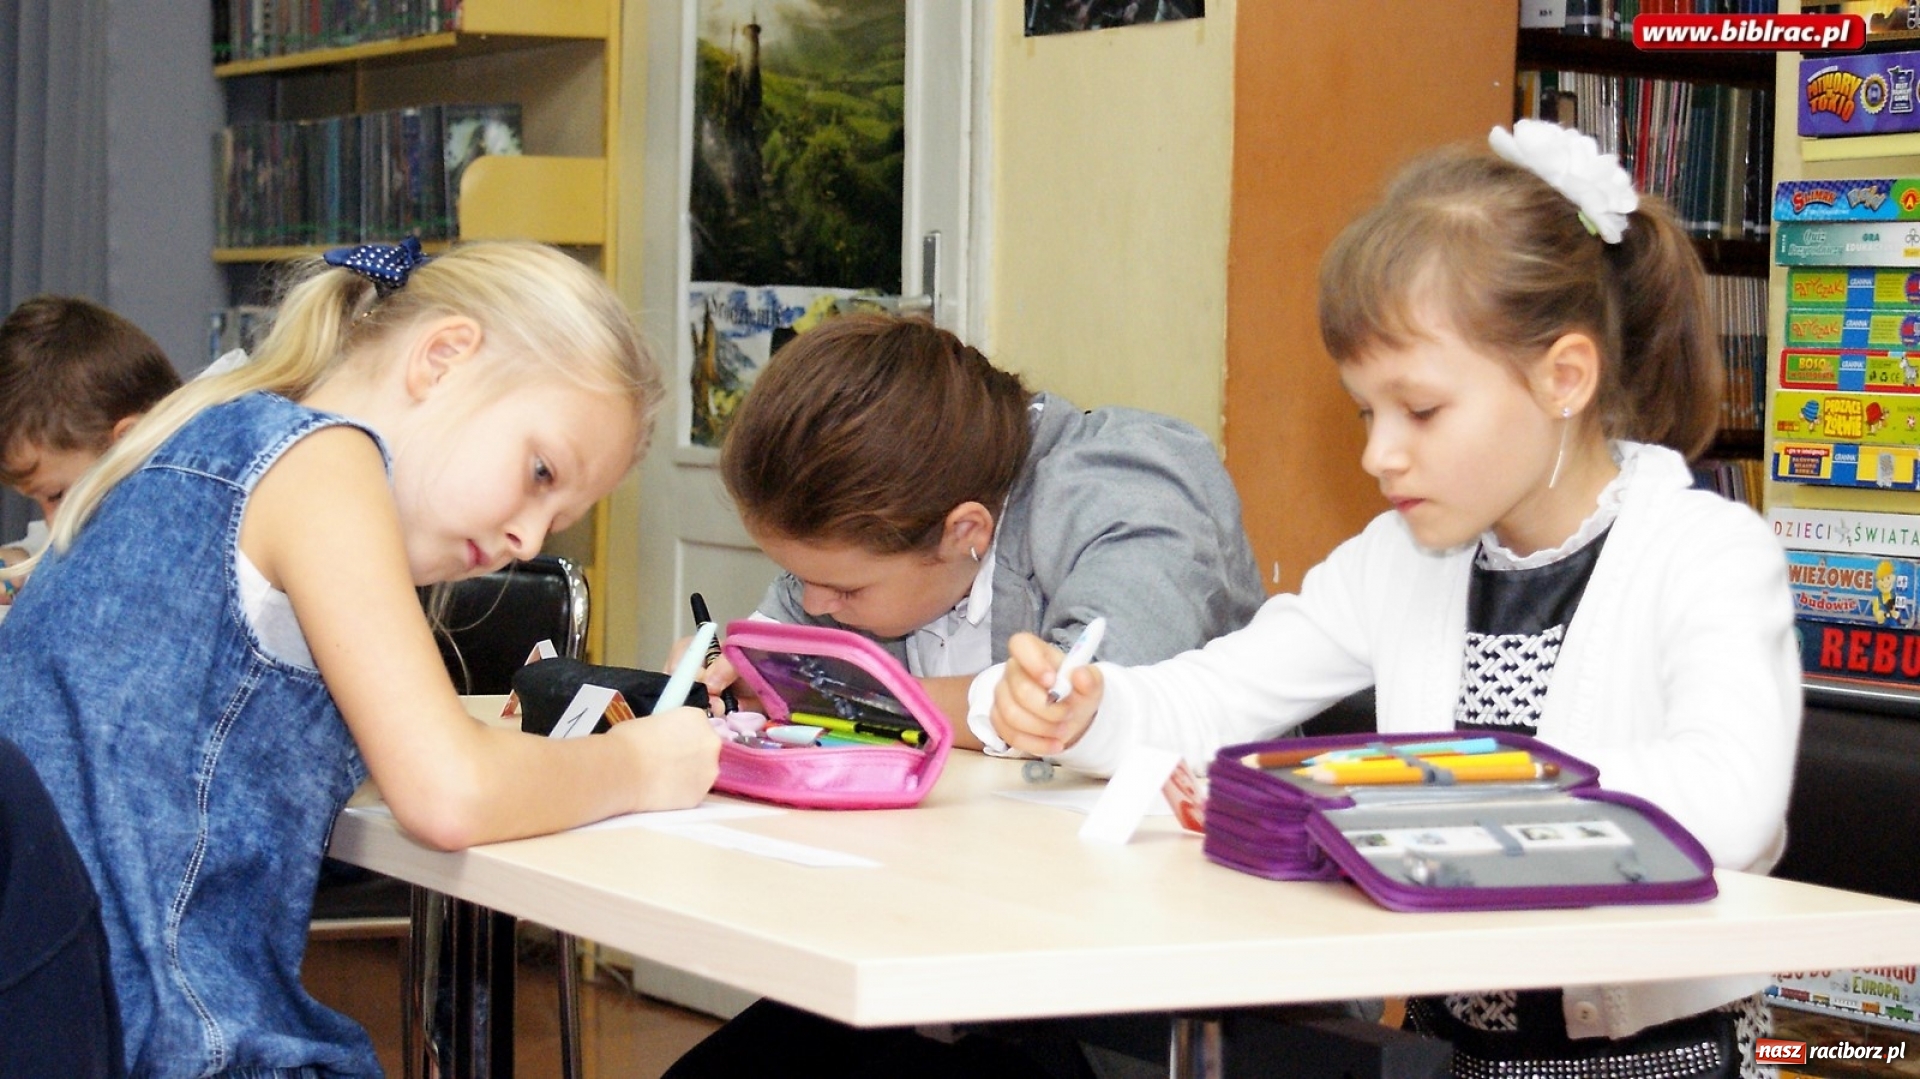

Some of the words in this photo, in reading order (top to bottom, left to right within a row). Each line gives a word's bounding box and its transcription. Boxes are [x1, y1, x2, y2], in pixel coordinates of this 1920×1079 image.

[1862, 233, 1880, 242] GRA
[1774, 520, 1831, 540] DZIECI
[1854, 522, 1920, 546] ŚWIATA
[1788, 561, 1874, 590] WIEŻOWCE
[1800, 592, 1857, 611] budowie
[1852, 976, 1900, 1001] EUROPA
